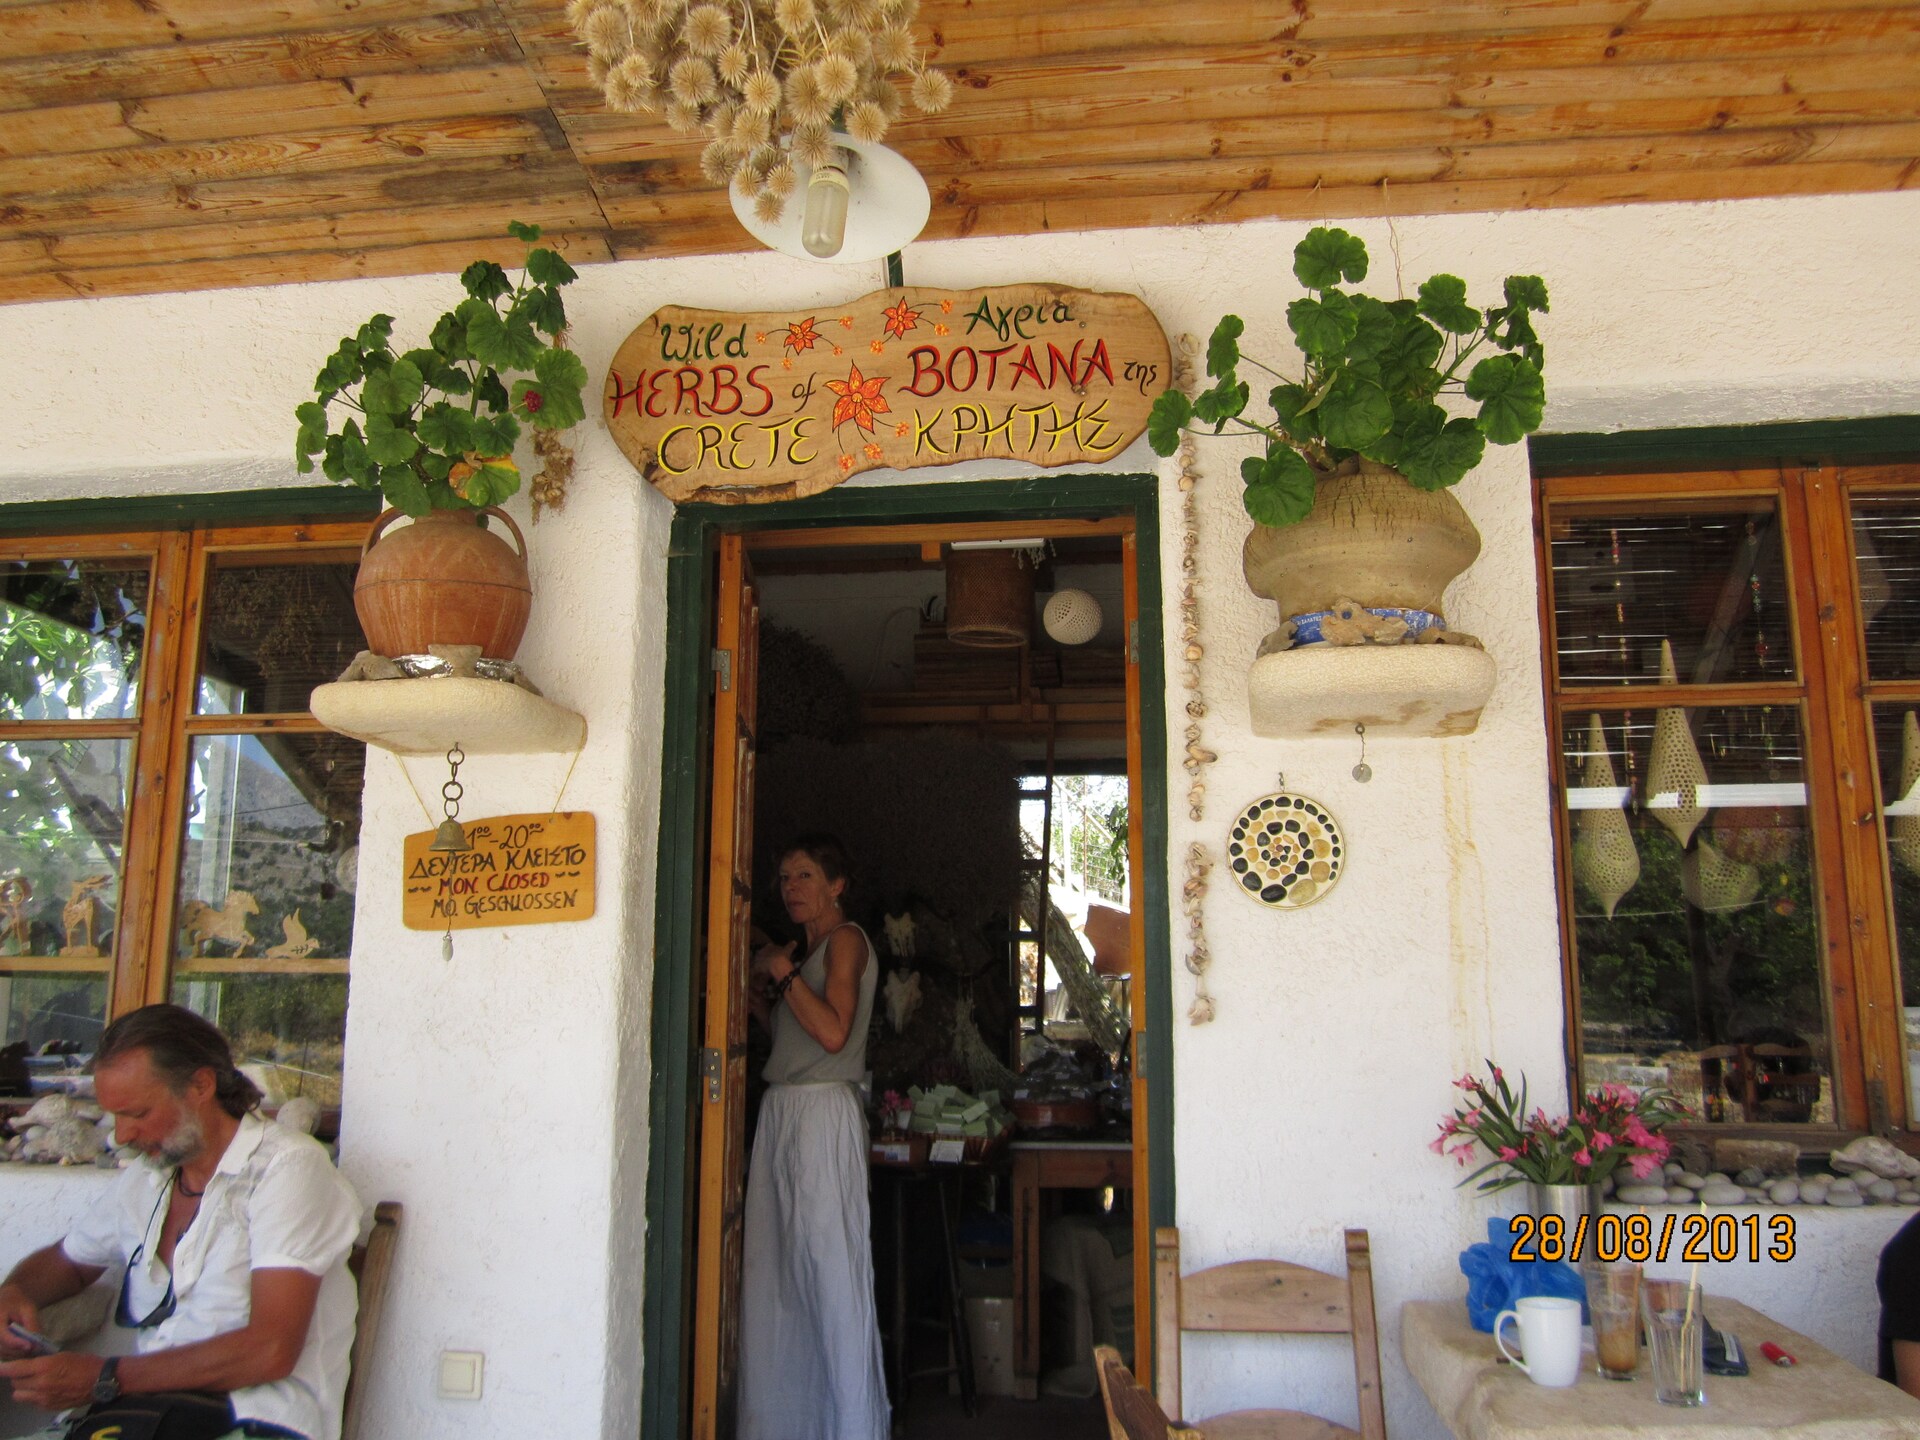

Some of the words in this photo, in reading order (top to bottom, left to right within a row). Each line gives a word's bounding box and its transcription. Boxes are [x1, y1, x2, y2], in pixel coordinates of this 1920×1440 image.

[660, 322, 748, 362] Wild
[608, 364, 774, 419] HERBS
[790, 371, 817, 413] of
[656, 416, 818, 475] CRETE
[914, 399, 1125, 458] ΚΡΗΤΗΣ
[408, 851, 496, 880] ΔΕΥΤΕΡΑ
[506, 843, 587, 872] ΚΛΕΙΣΤΟ
[487, 871, 550, 892] CLOSED
